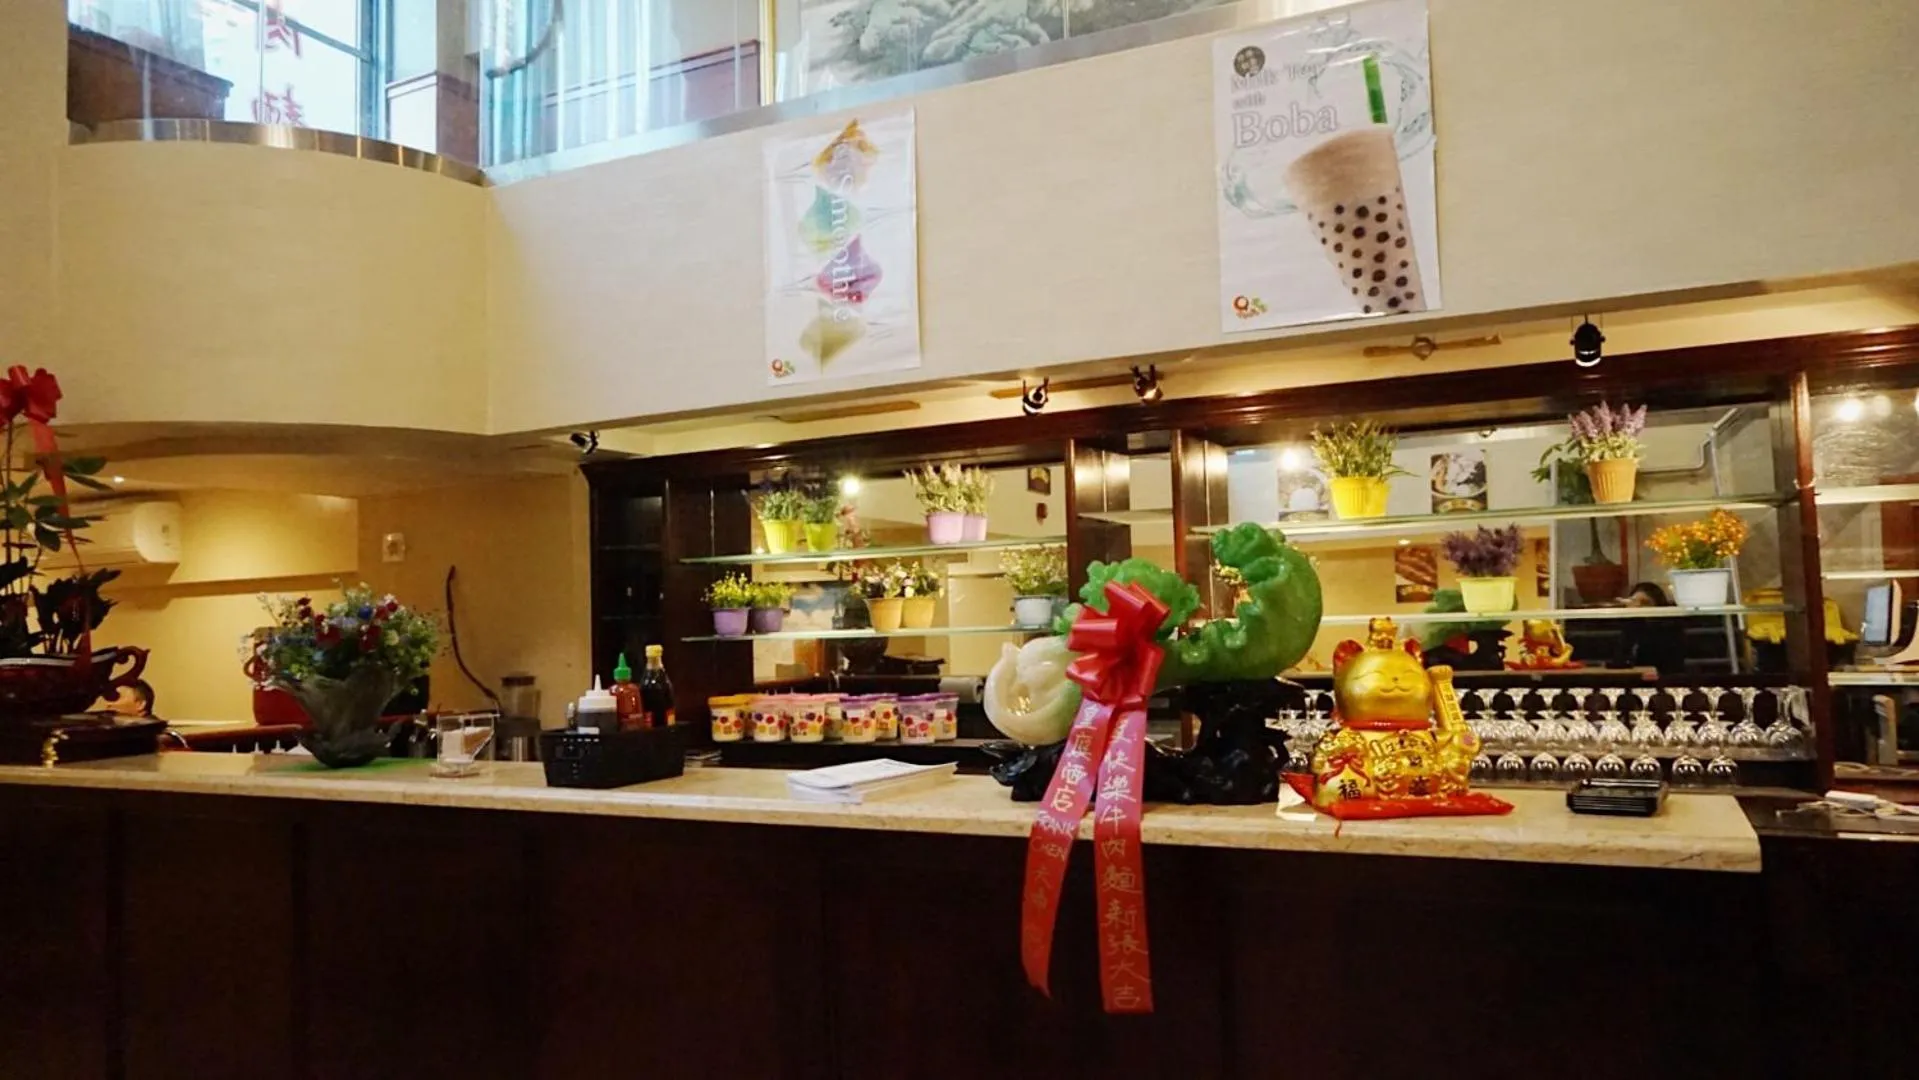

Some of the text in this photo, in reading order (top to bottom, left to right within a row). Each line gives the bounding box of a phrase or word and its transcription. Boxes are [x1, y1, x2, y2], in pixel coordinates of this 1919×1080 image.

[1231, 100, 1338, 149] Boba
[831, 173, 855, 322] Smoothie
[1338, 778, 1362, 800] 福
